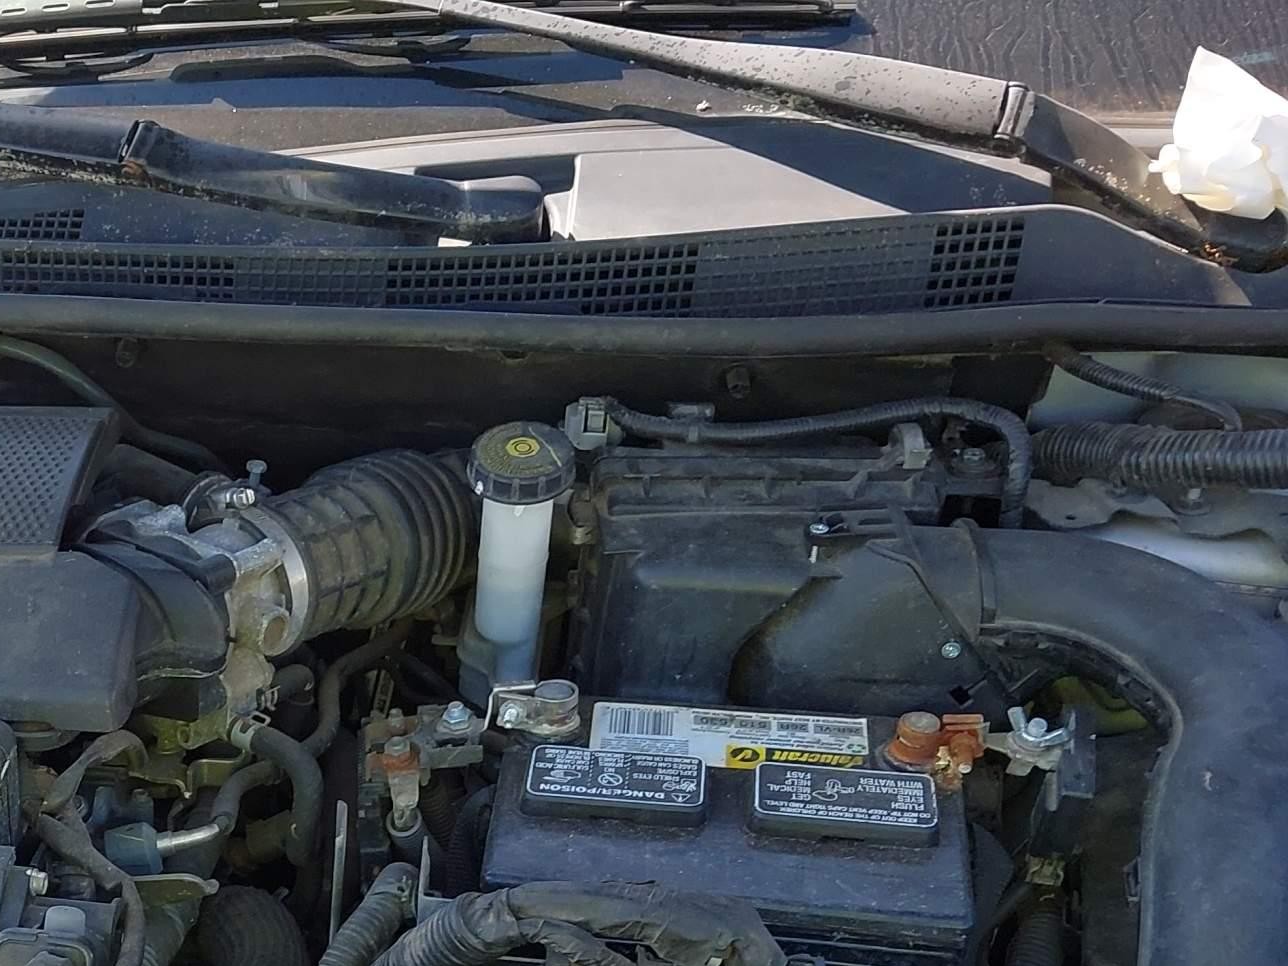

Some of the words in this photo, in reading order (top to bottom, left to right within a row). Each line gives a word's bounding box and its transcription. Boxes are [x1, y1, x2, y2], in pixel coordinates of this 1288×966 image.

[786, 771, 811, 779] FAST
[785, 778, 812, 786] HELP
[859, 778, 895, 786] WATER
[897, 780, 923, 788] WITH
[540, 783, 665, 799] DANGER/POISON
[766, 784, 811, 793] MEDICAL
[856, 785, 923, 795] IMMEDIATELY
[791, 793, 811, 801] GET
[891, 802, 924, 810] FLUSH
